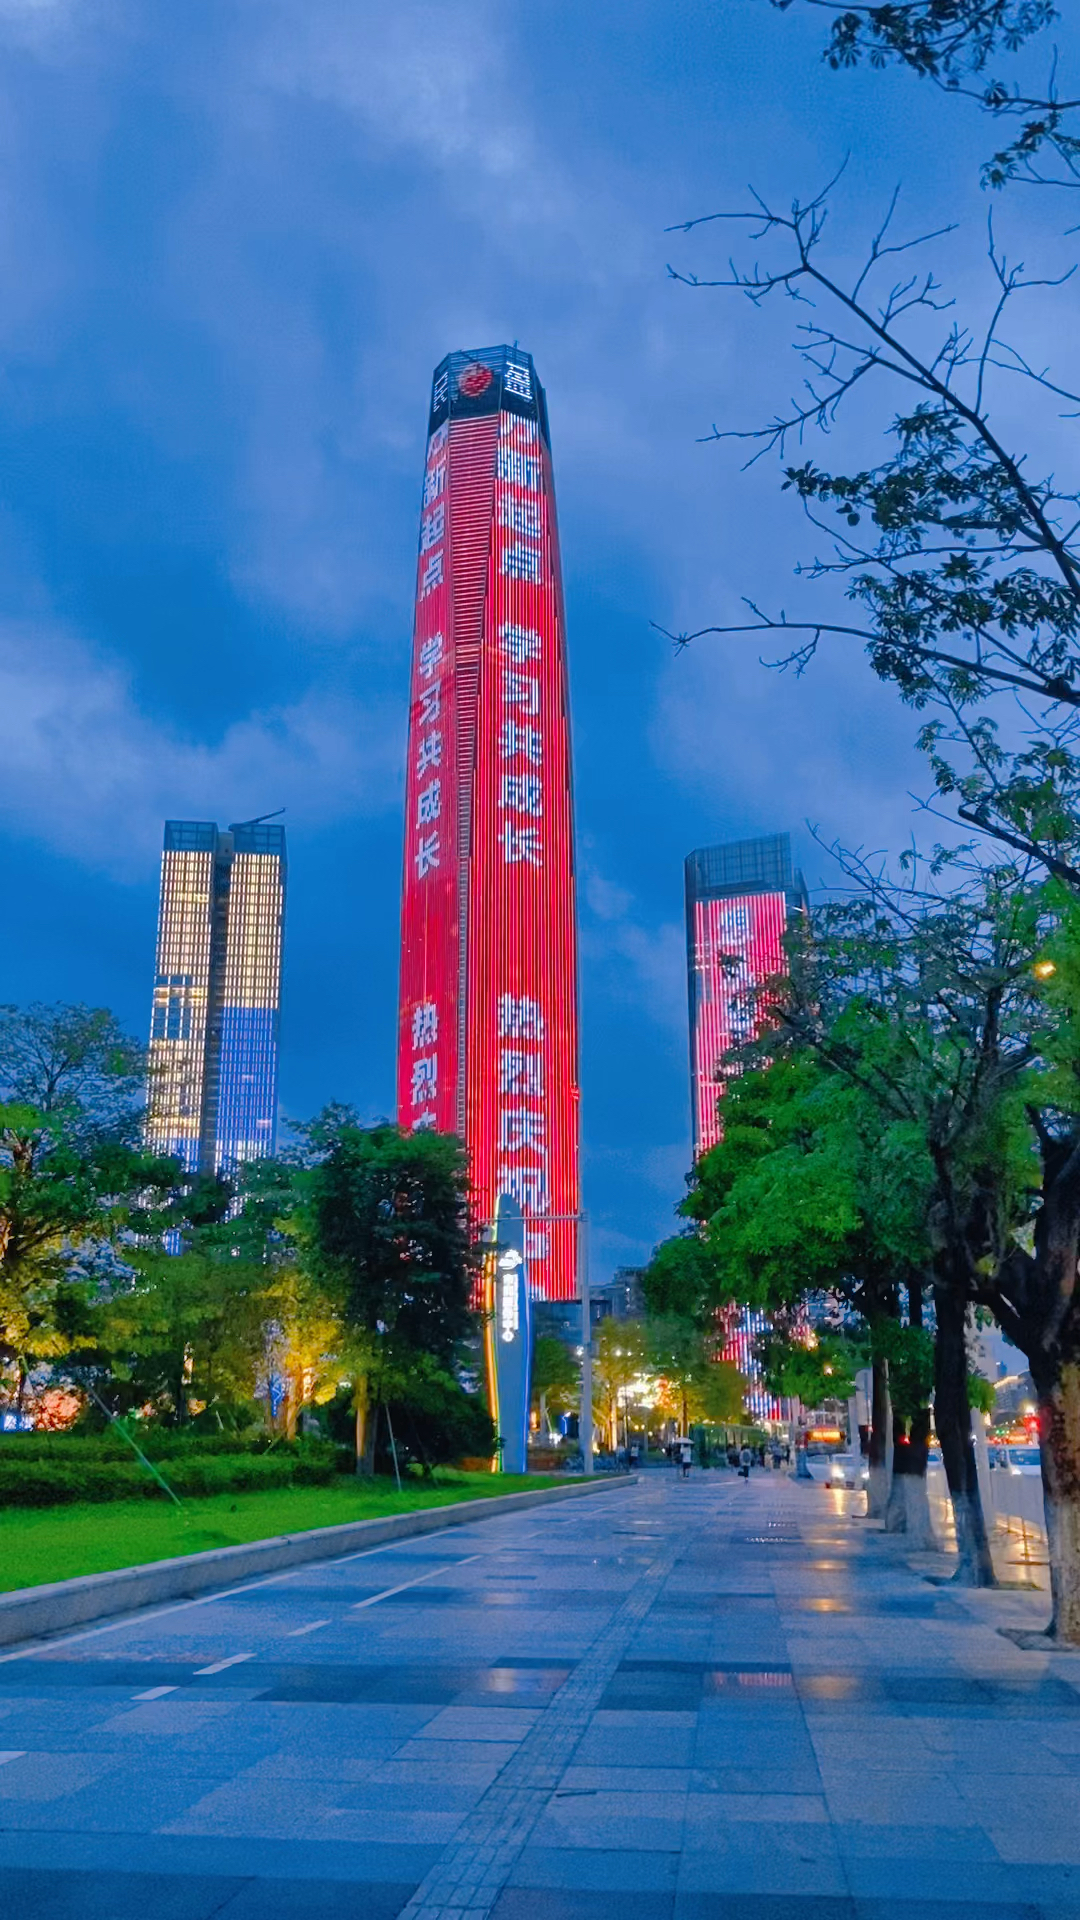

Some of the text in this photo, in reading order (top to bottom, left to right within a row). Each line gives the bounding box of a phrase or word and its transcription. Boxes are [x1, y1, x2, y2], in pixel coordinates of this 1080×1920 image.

[415, 631, 443, 879] 学习共成长
[497, 620, 543, 867] 学习共成长
[497, 991, 548, 1300] 热烈庆祝
